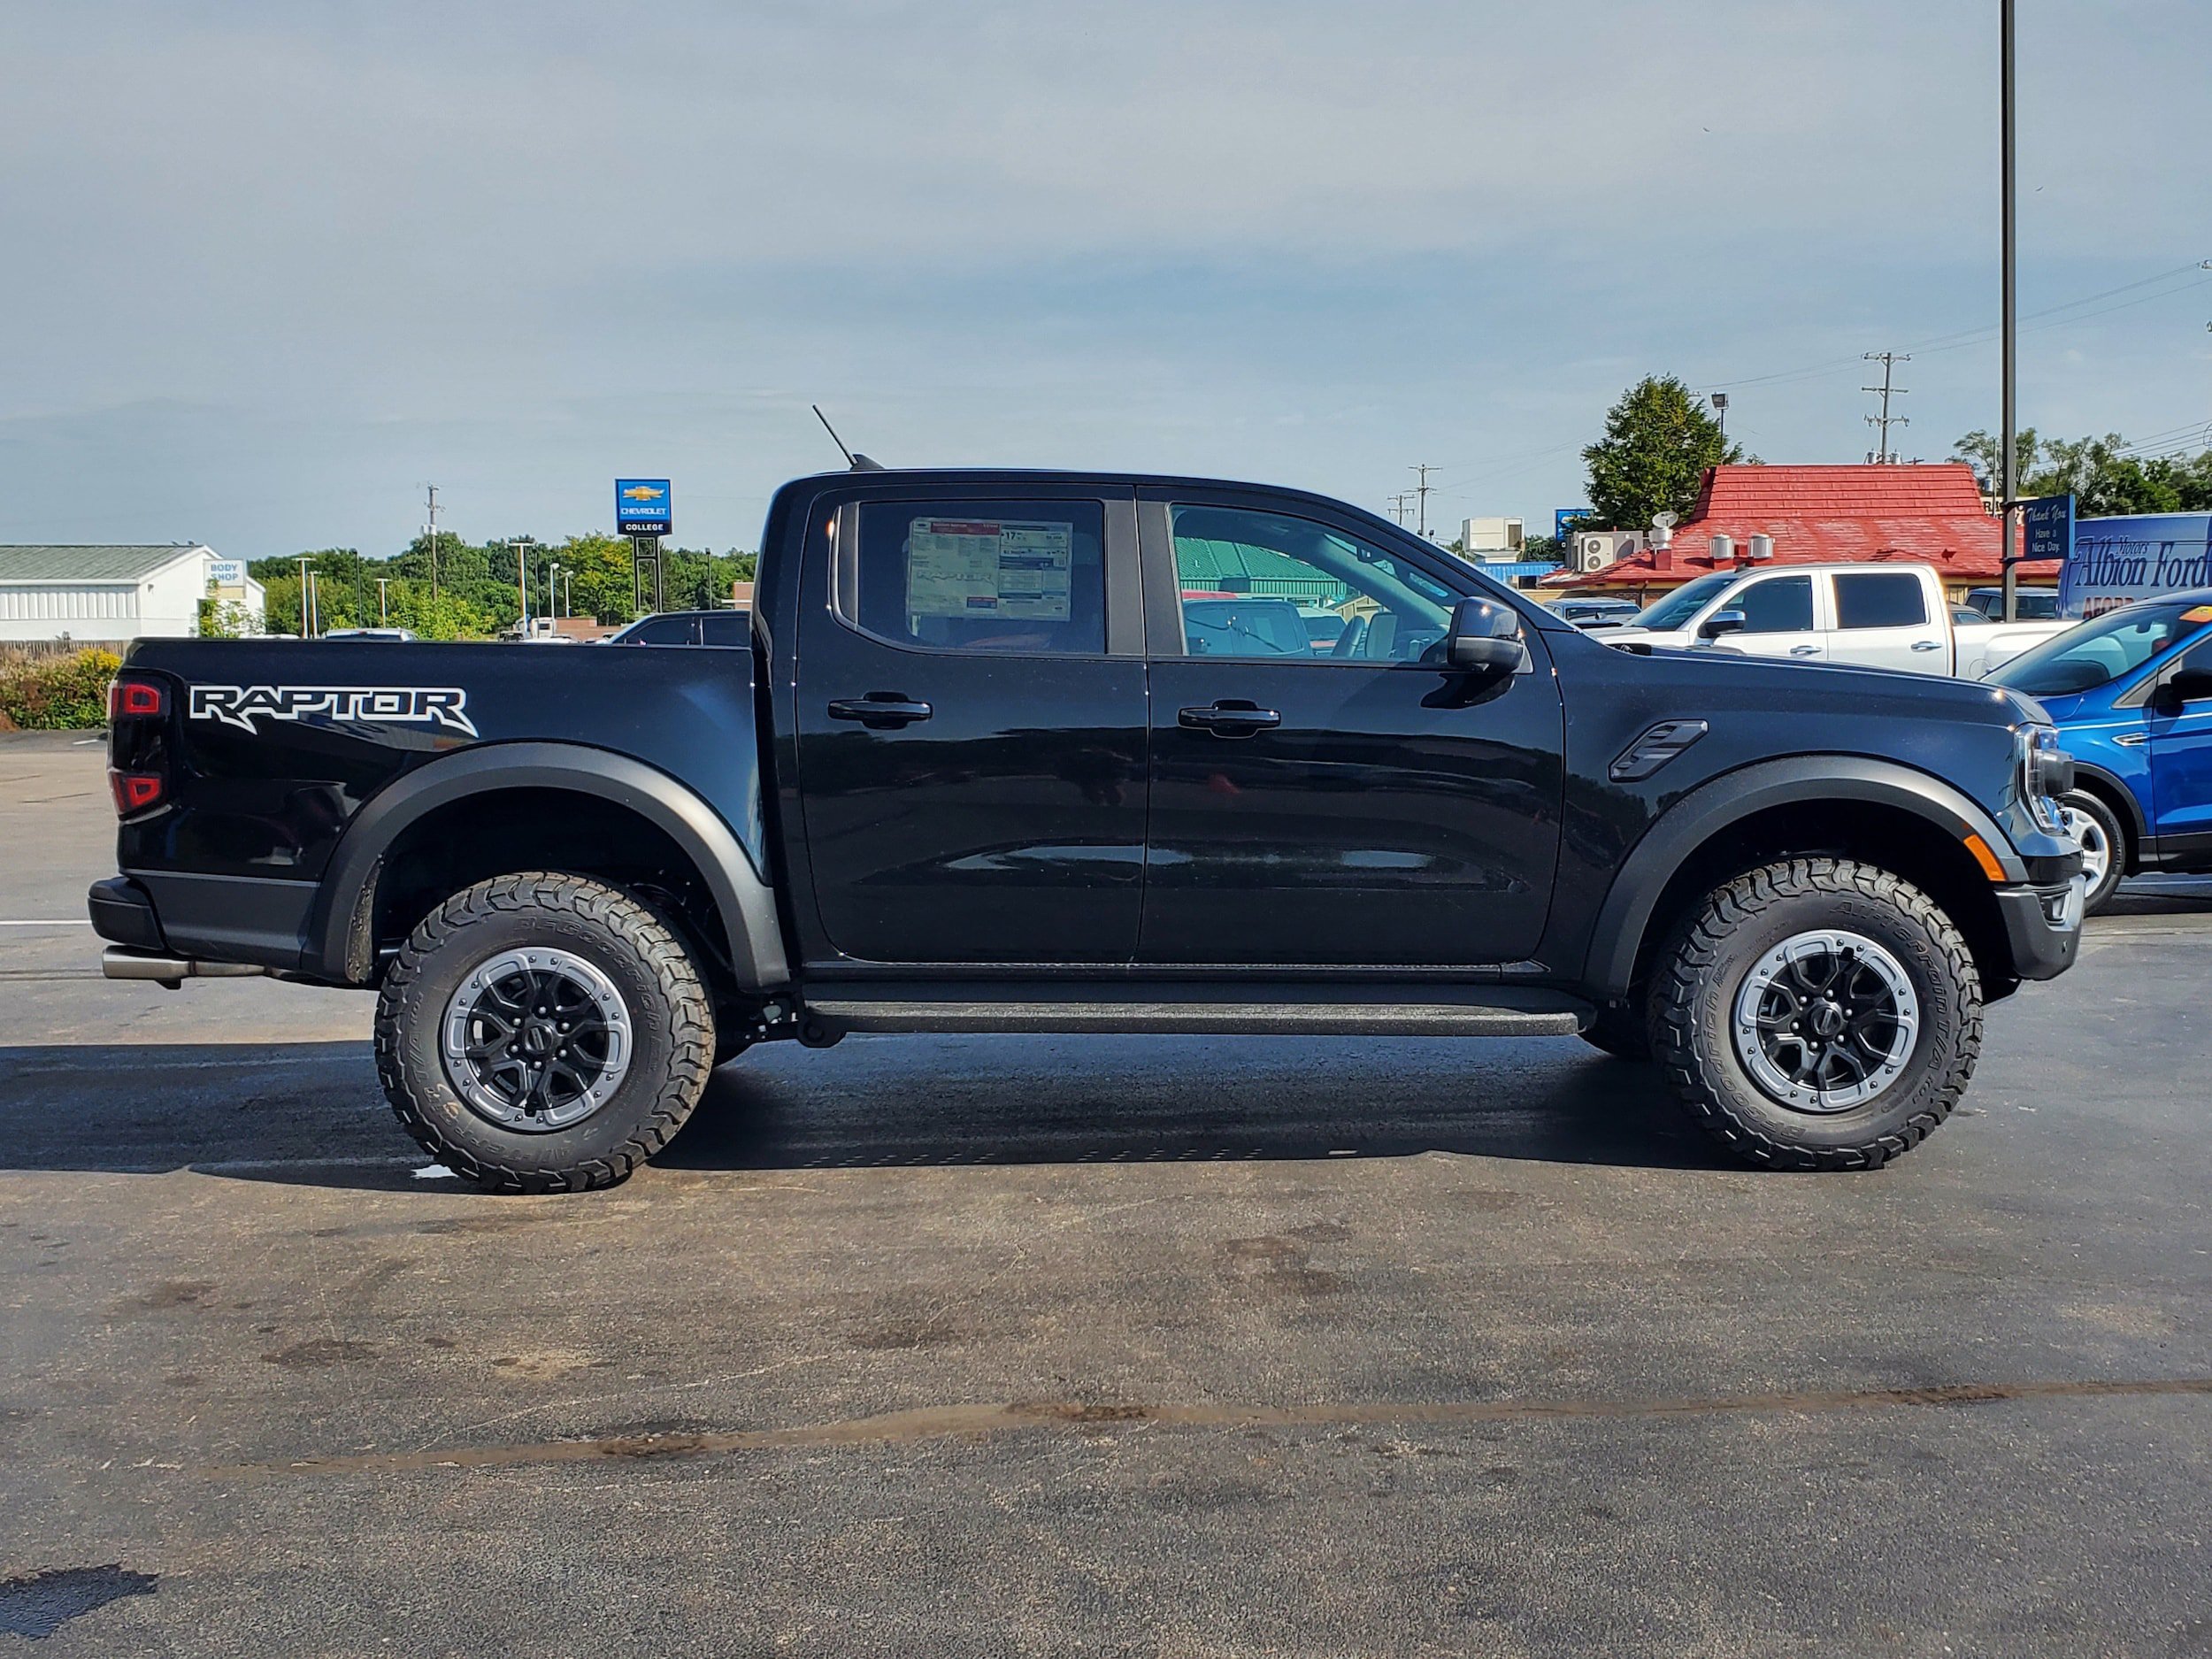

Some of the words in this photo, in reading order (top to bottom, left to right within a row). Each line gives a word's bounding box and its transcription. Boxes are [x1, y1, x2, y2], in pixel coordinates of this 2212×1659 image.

[2026, 507, 2049, 523] Thank
[2051, 503, 2067, 524] You
[2035, 528, 2050, 539] Have
[2032, 541, 2046, 553] Nice
[2074, 535, 2147, 588] Albion
[2150, 541, 2212, 588] Ford
[211, 572, 239, 581] SHOP
[189, 686, 479, 739] RAPTOR
[512, 916, 662, 1032] BFGoodrich
[1704, 989, 1808, 1141] BFGoodrich
[1927, 1019, 1952, 1071] T/A
